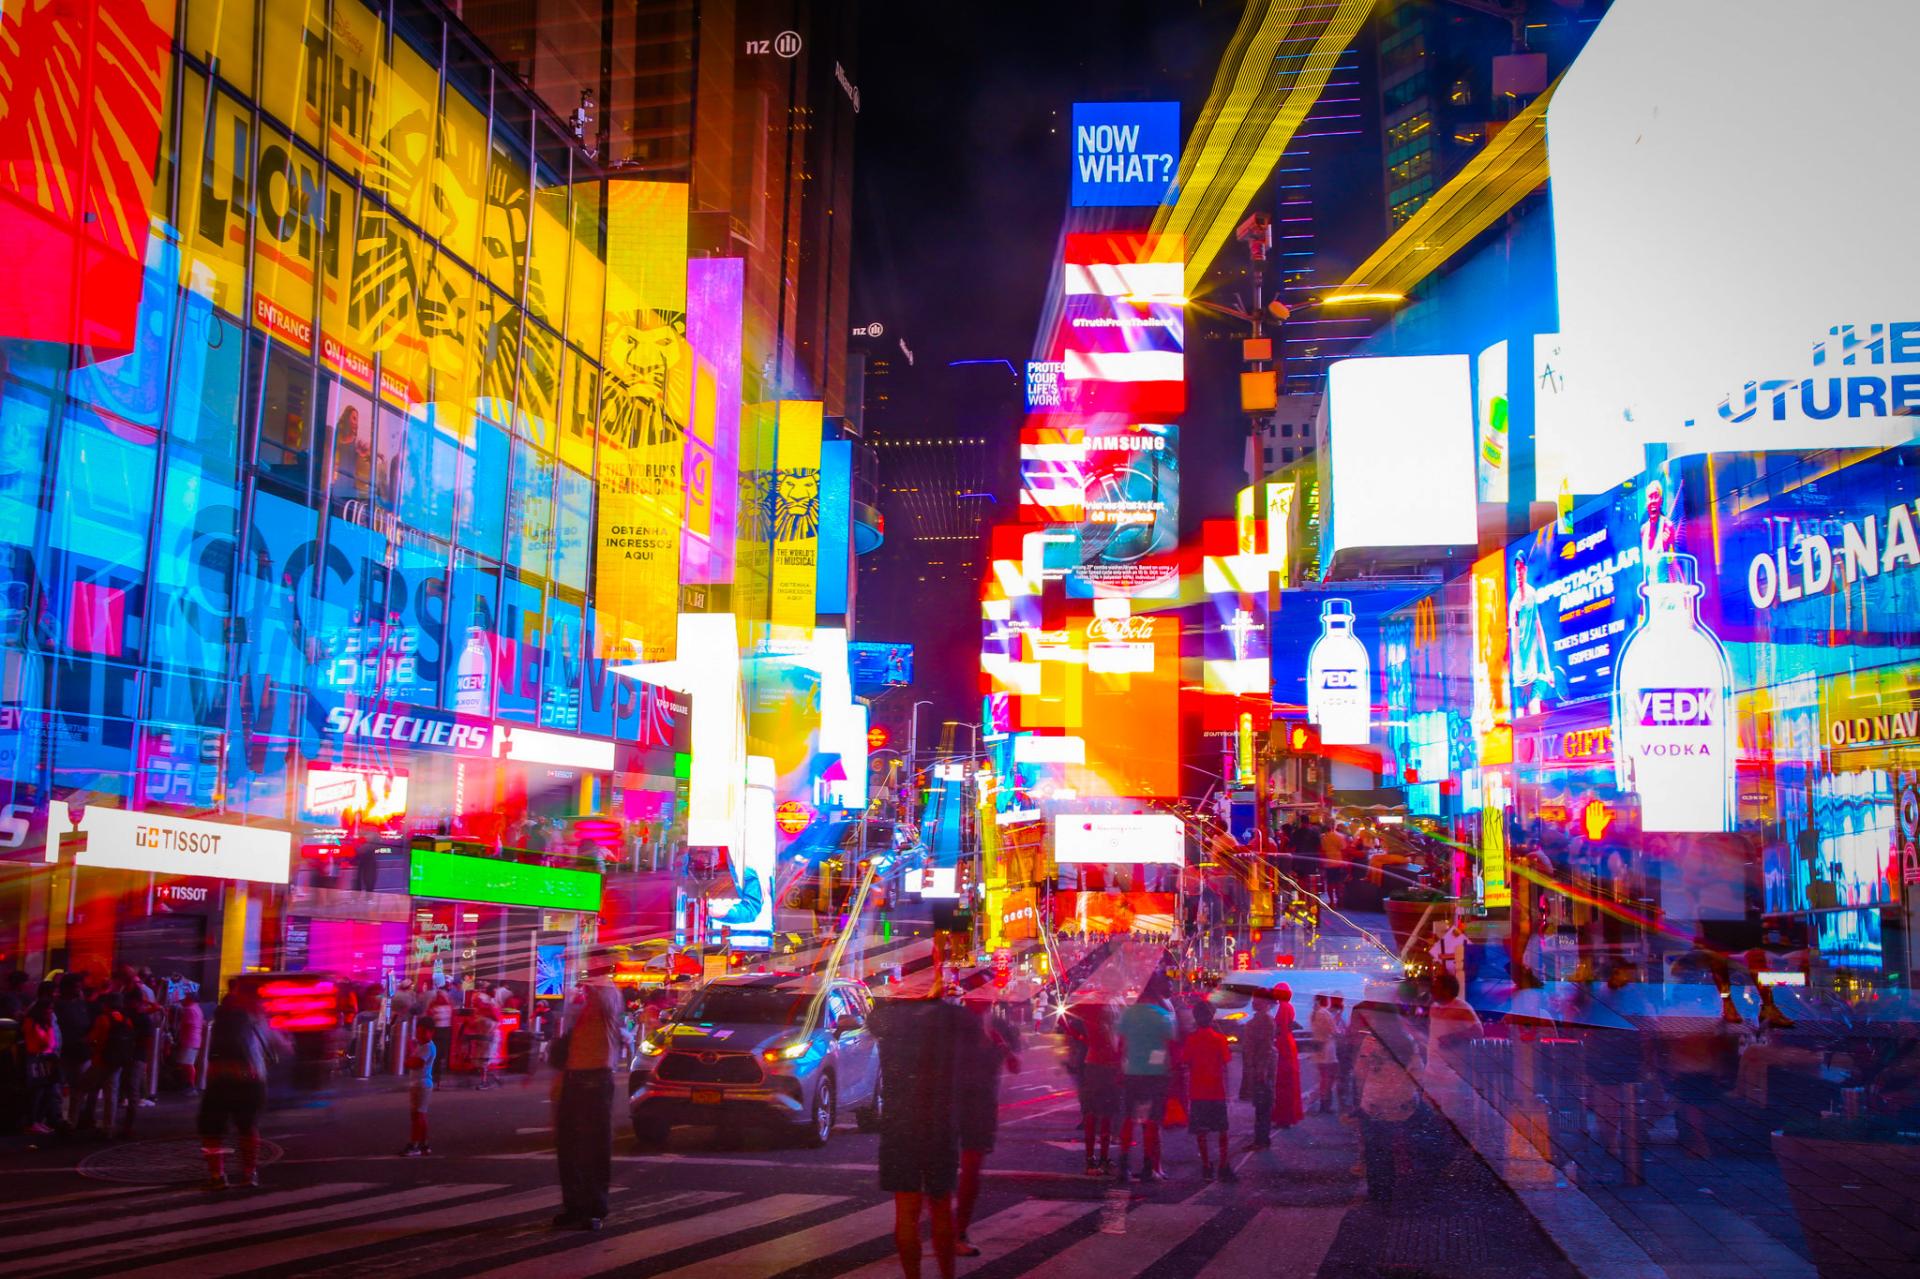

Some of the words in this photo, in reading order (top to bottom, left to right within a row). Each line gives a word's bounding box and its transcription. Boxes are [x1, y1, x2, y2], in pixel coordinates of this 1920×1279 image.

[746, 40, 770, 55] nz
[1078, 124, 1140, 154] NOW
[1078, 153, 1174, 183] WHAT?
[258, 300, 310, 343] ENTRANCE
[324, 339, 340, 360] ON
[346, 351, 369, 378] 45TH
[1028, 373, 1057, 383] YOUR
[1028, 394, 1060, 406] WORK
[1083, 436, 1165, 450] SAMSUNG
[611, 526, 668, 536] OBTENHA
[606, 538, 672, 549] INGRESSOS
[625, 551, 654, 561] AQUI
[1748, 534, 1832, 609] OLD
[1843, 497, 1920, 584] NA
[323, 706, 488, 749] SKECHERS
[1832, 718, 1871, 745] OLD
[1641, 743, 1711, 756] VODKA
[162, 829, 222, 855] TISSOT
[171, 885, 208, 901] TISSOT
